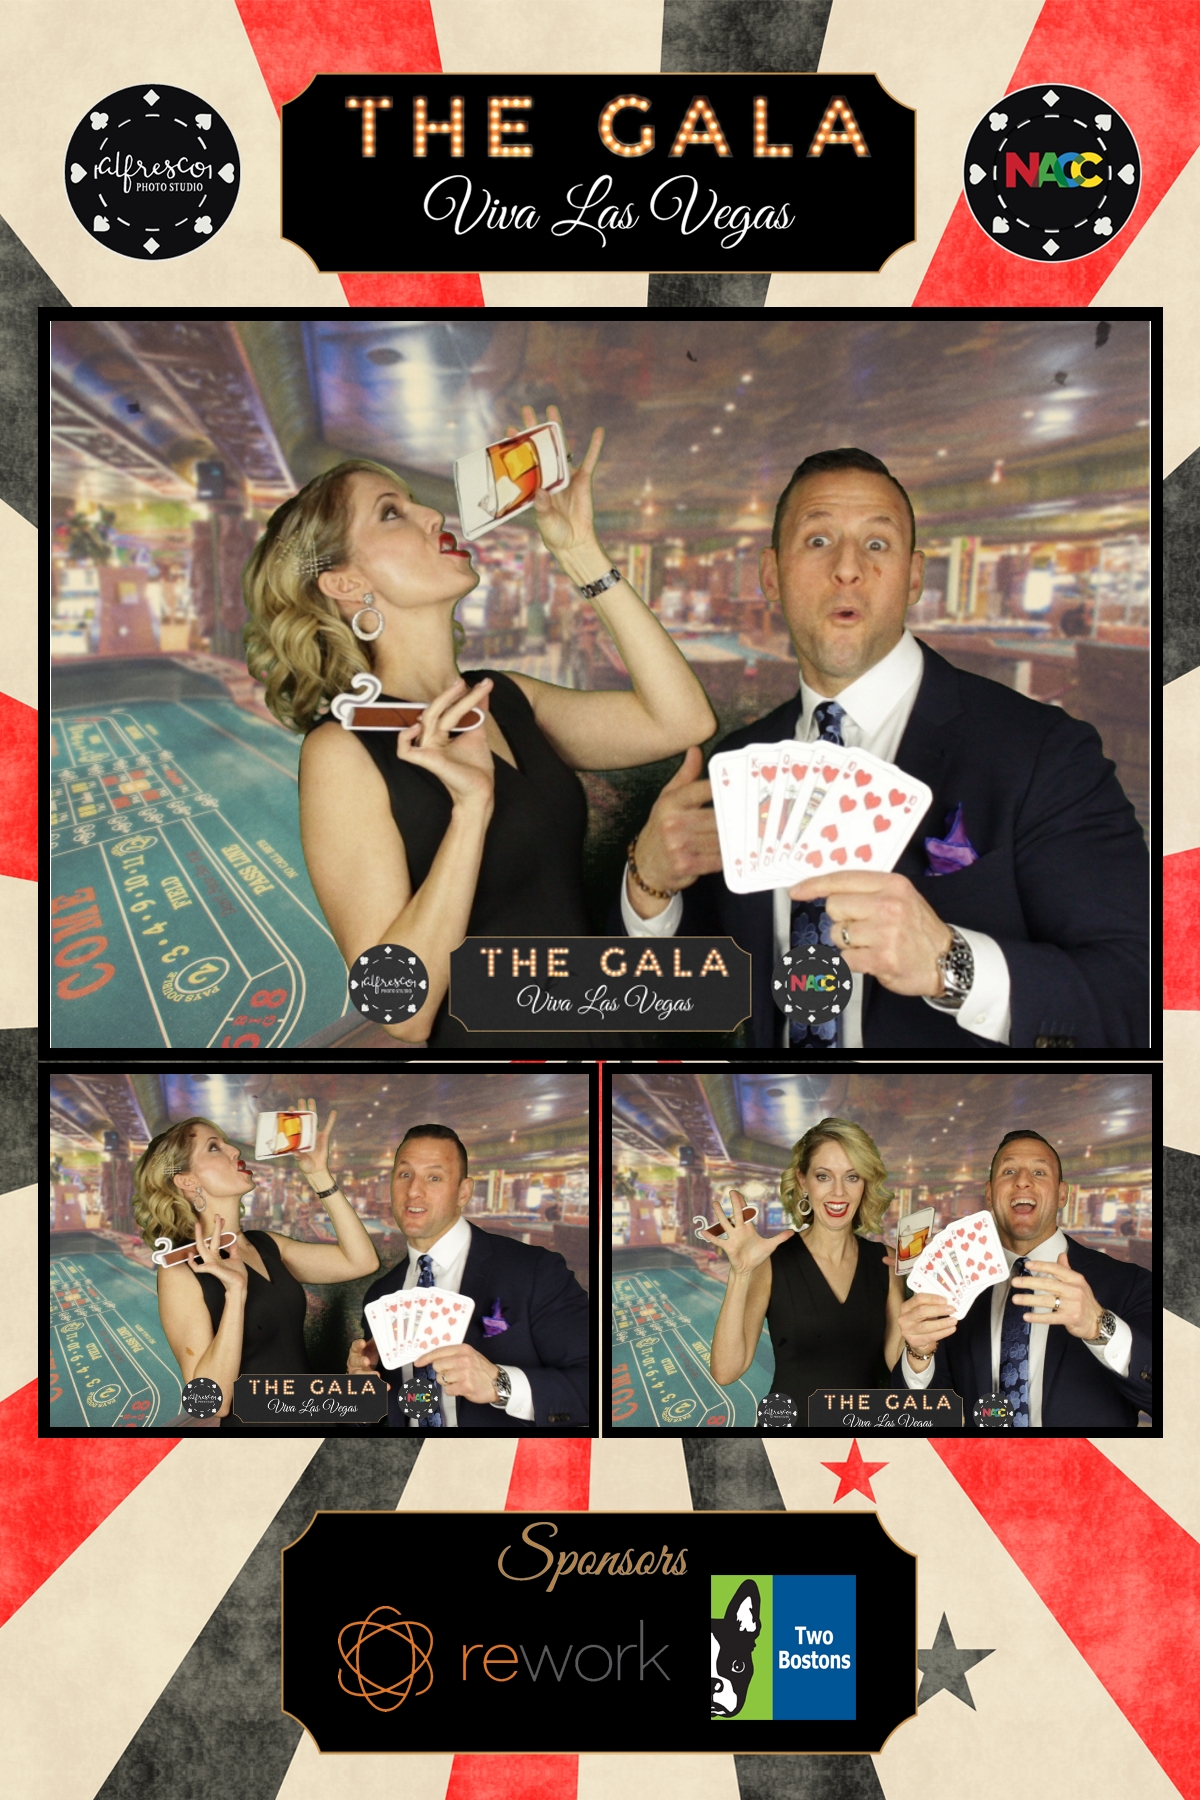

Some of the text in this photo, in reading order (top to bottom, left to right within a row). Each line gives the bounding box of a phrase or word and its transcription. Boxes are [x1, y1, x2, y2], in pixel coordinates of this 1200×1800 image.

[221, 843, 275, 897] PASS LINE
[160, 876, 193, 910] FIELD
[51, 886, 116, 1000] COME
[161, 971, 220, 1002] PAYS DOUBLE
[188, 962, 219, 984] 2
[250, 988, 288, 1009] 8
[233, 1015, 277, 1027] BIG
